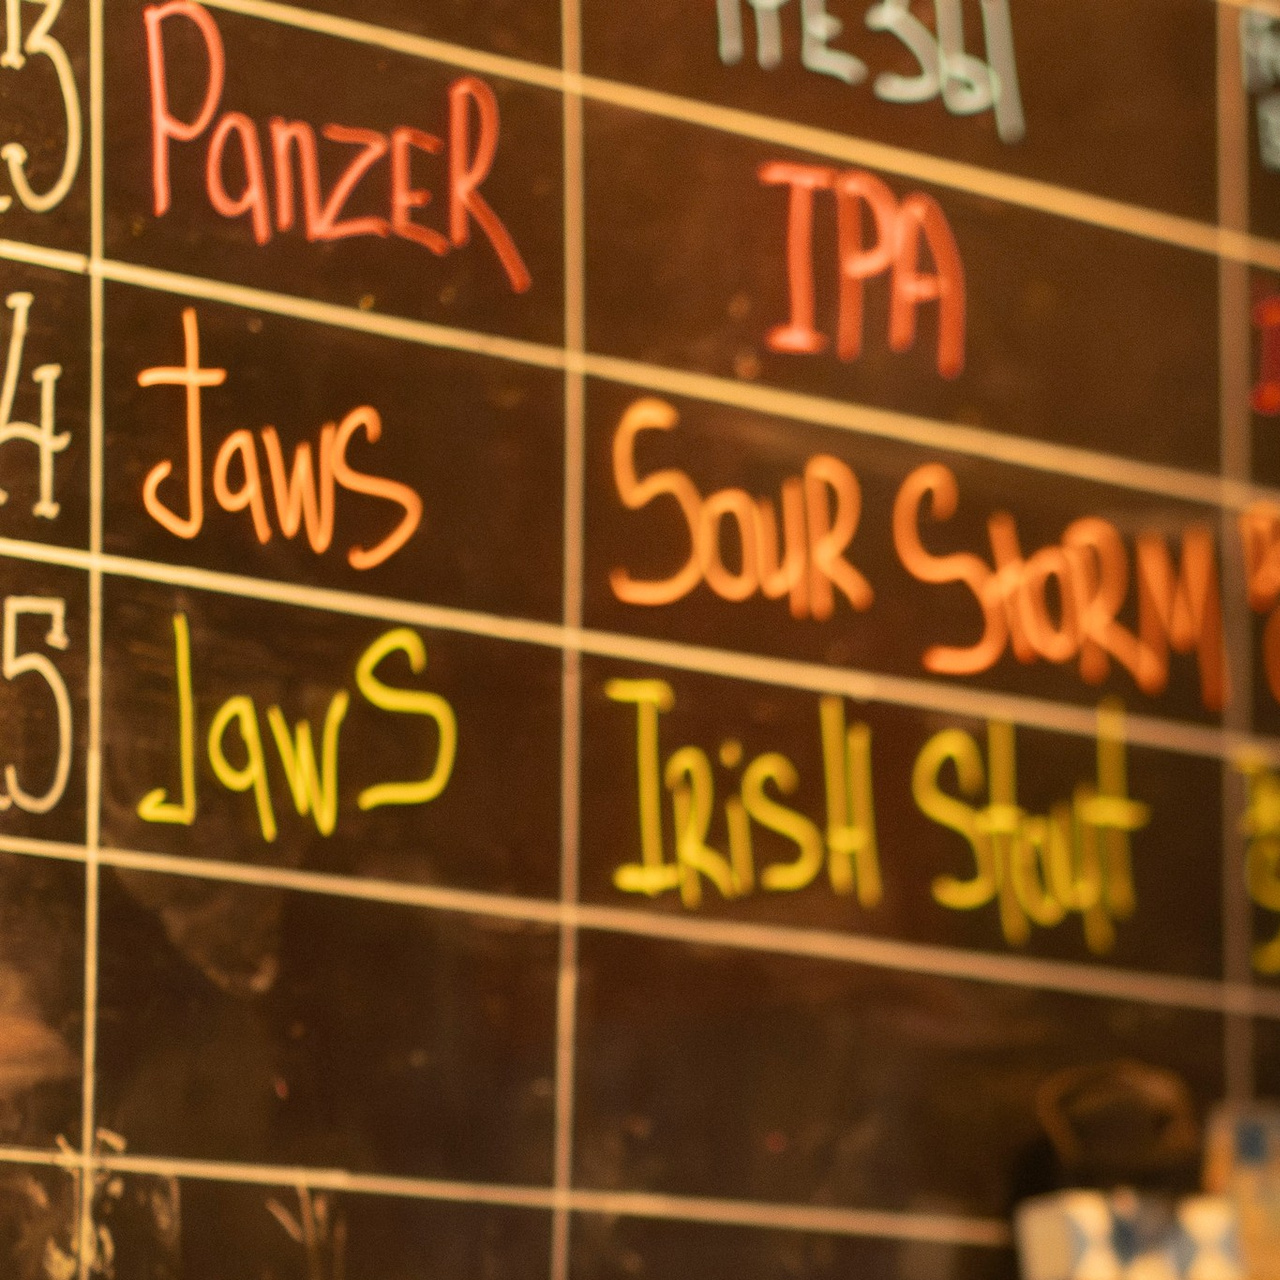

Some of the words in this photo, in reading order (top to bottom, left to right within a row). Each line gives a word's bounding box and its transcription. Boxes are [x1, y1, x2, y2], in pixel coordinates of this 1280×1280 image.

[0, 0, 83, 213] 3
[758, 160, 966, 379] IPA
[0, 291, 72, 520] 4
[0, 594, 74, 815] 5
